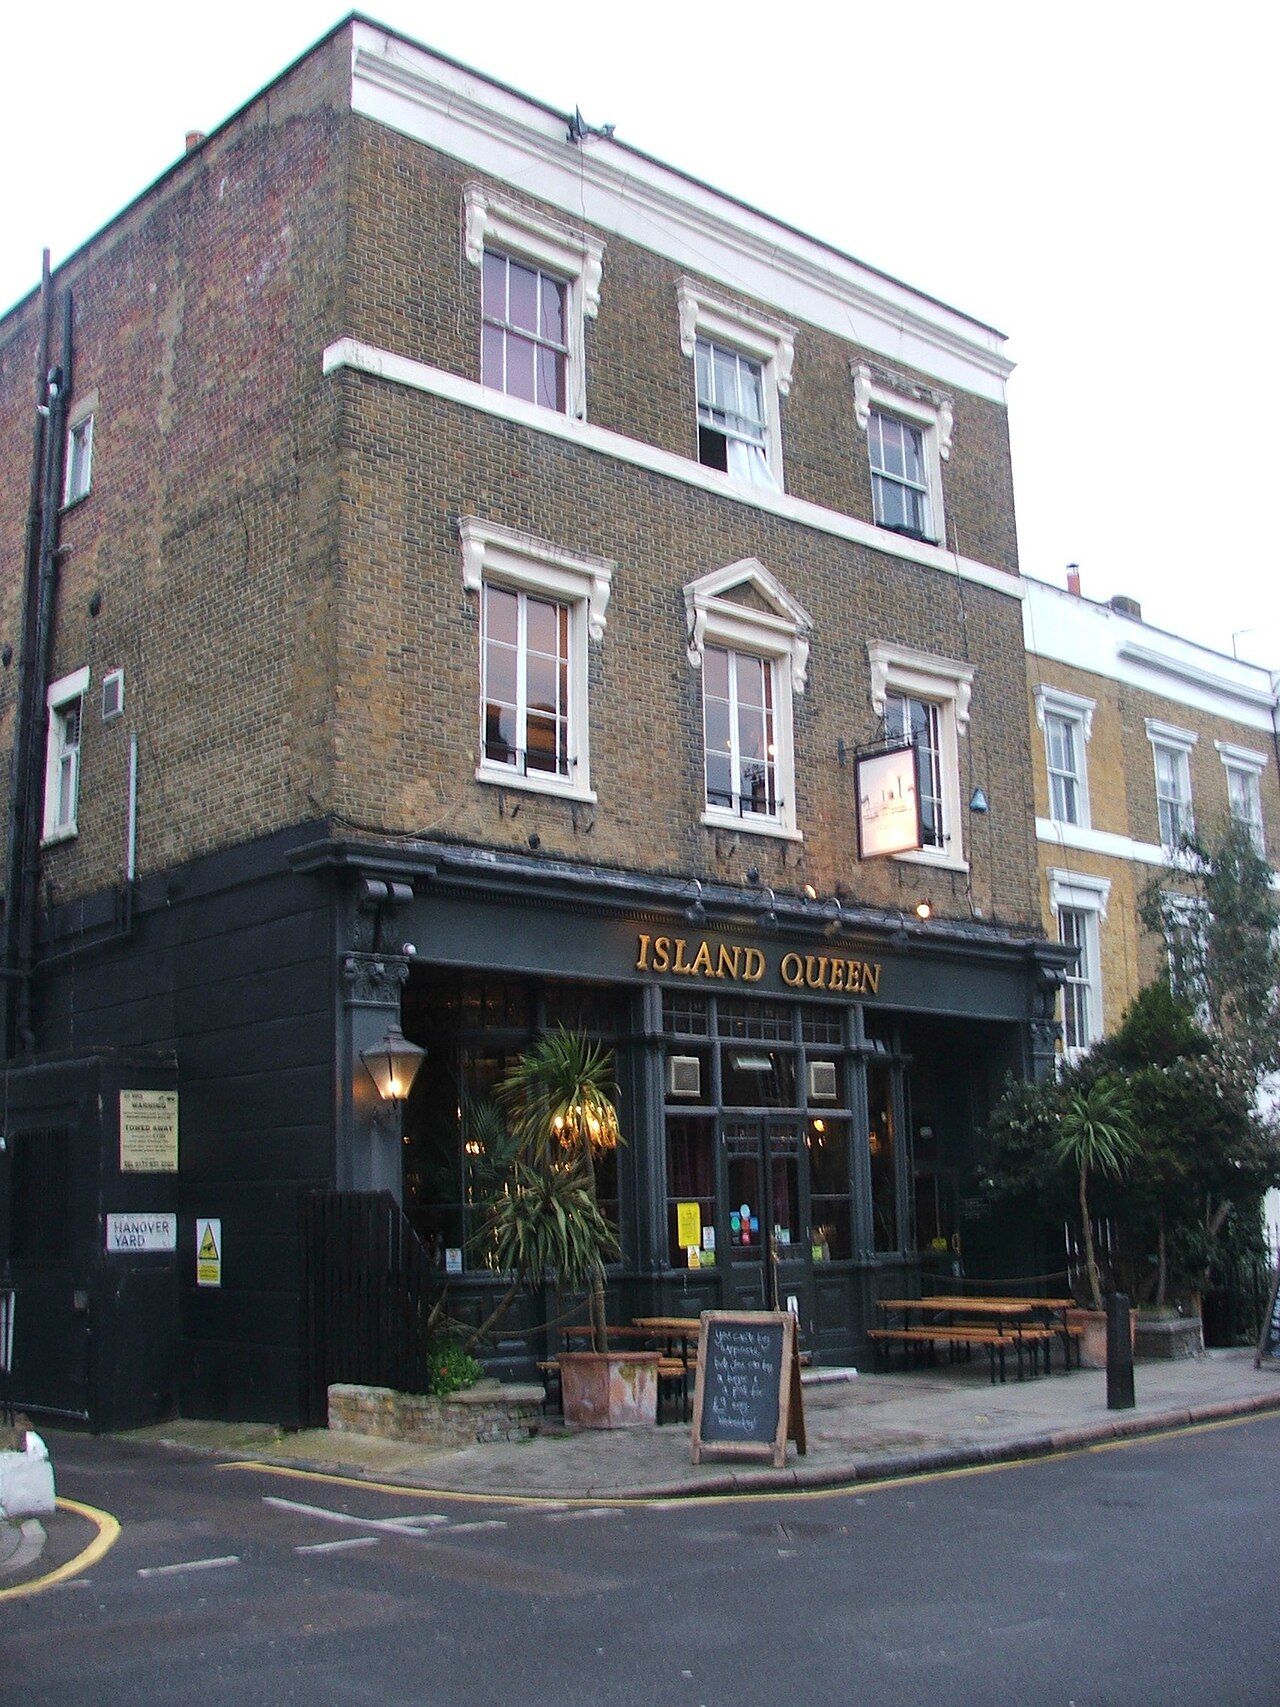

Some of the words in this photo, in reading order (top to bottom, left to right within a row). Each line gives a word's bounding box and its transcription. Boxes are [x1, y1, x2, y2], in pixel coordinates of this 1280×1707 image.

[637, 934, 766, 982] ISLAND
[780, 951, 881, 995] QUEEN
[125, 1124, 150, 1132] TOWED
[153, 1124, 173, 1132] AWAY
[114, 1221, 169, 1234] HANOVER
[115, 1234, 145, 1247] YARD
